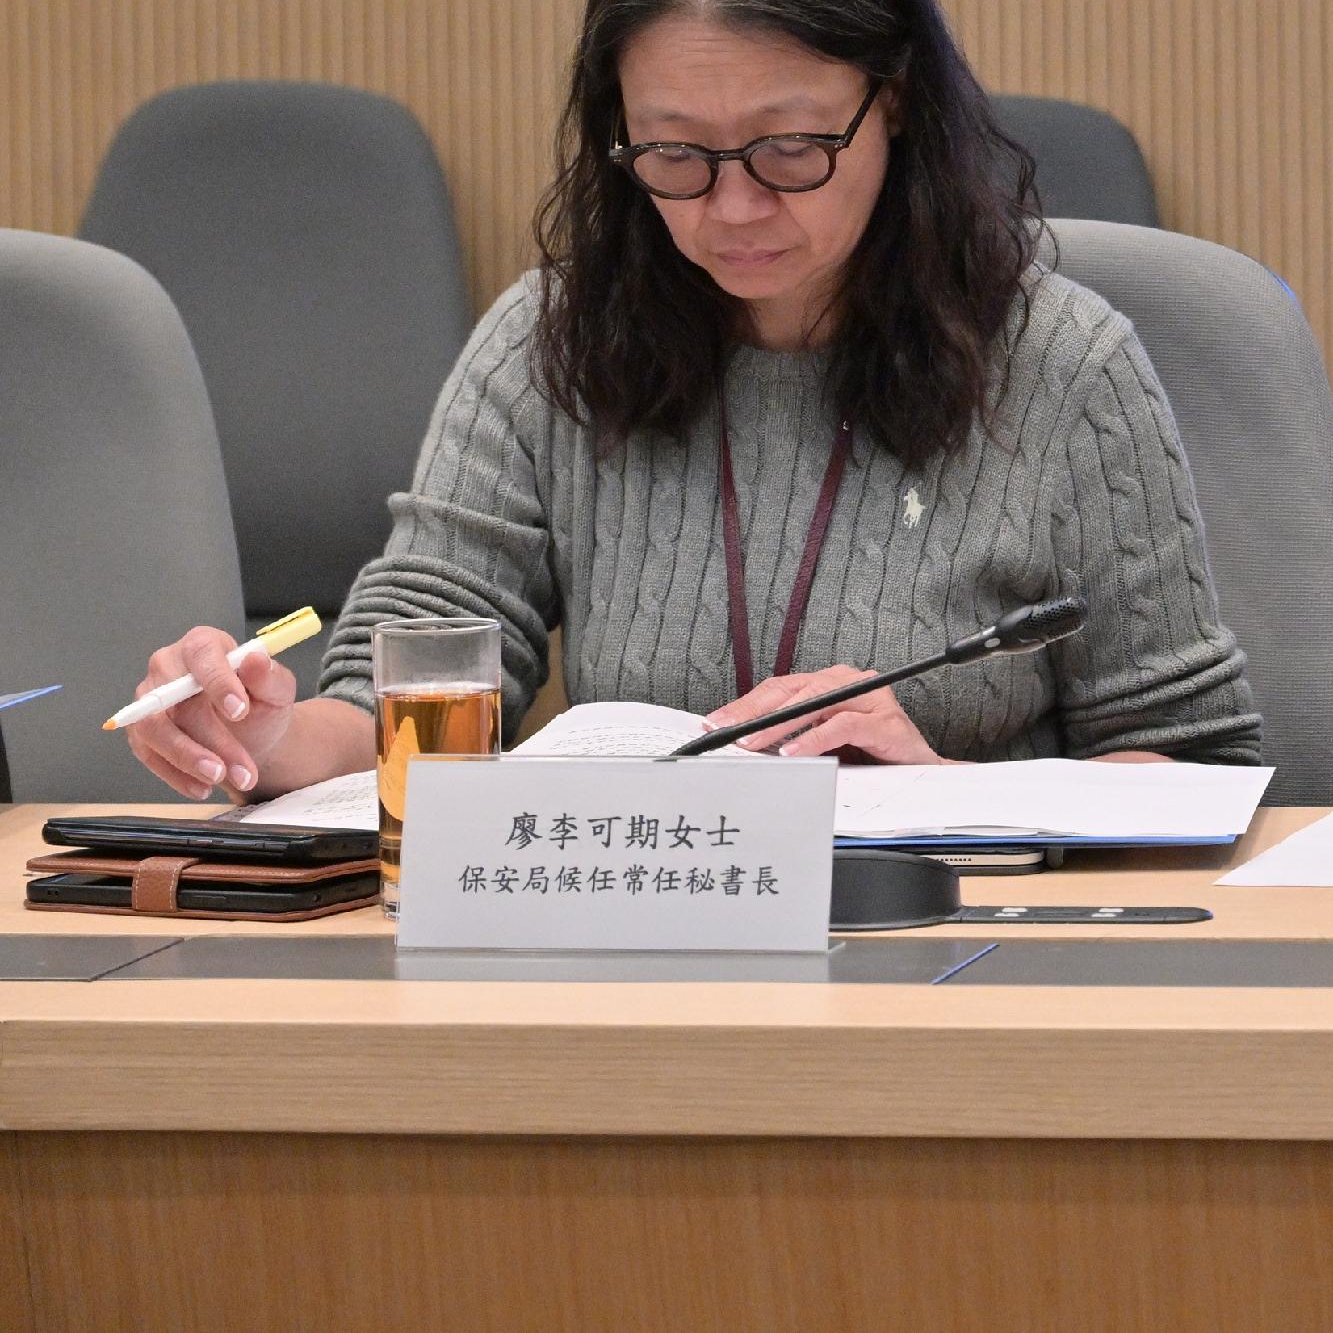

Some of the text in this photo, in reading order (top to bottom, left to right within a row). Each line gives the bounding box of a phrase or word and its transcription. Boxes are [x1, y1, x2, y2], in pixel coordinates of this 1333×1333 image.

[504, 812, 741, 851] 廖李可期女士
[458, 864, 780, 896] 保安局候任常任秘書長
